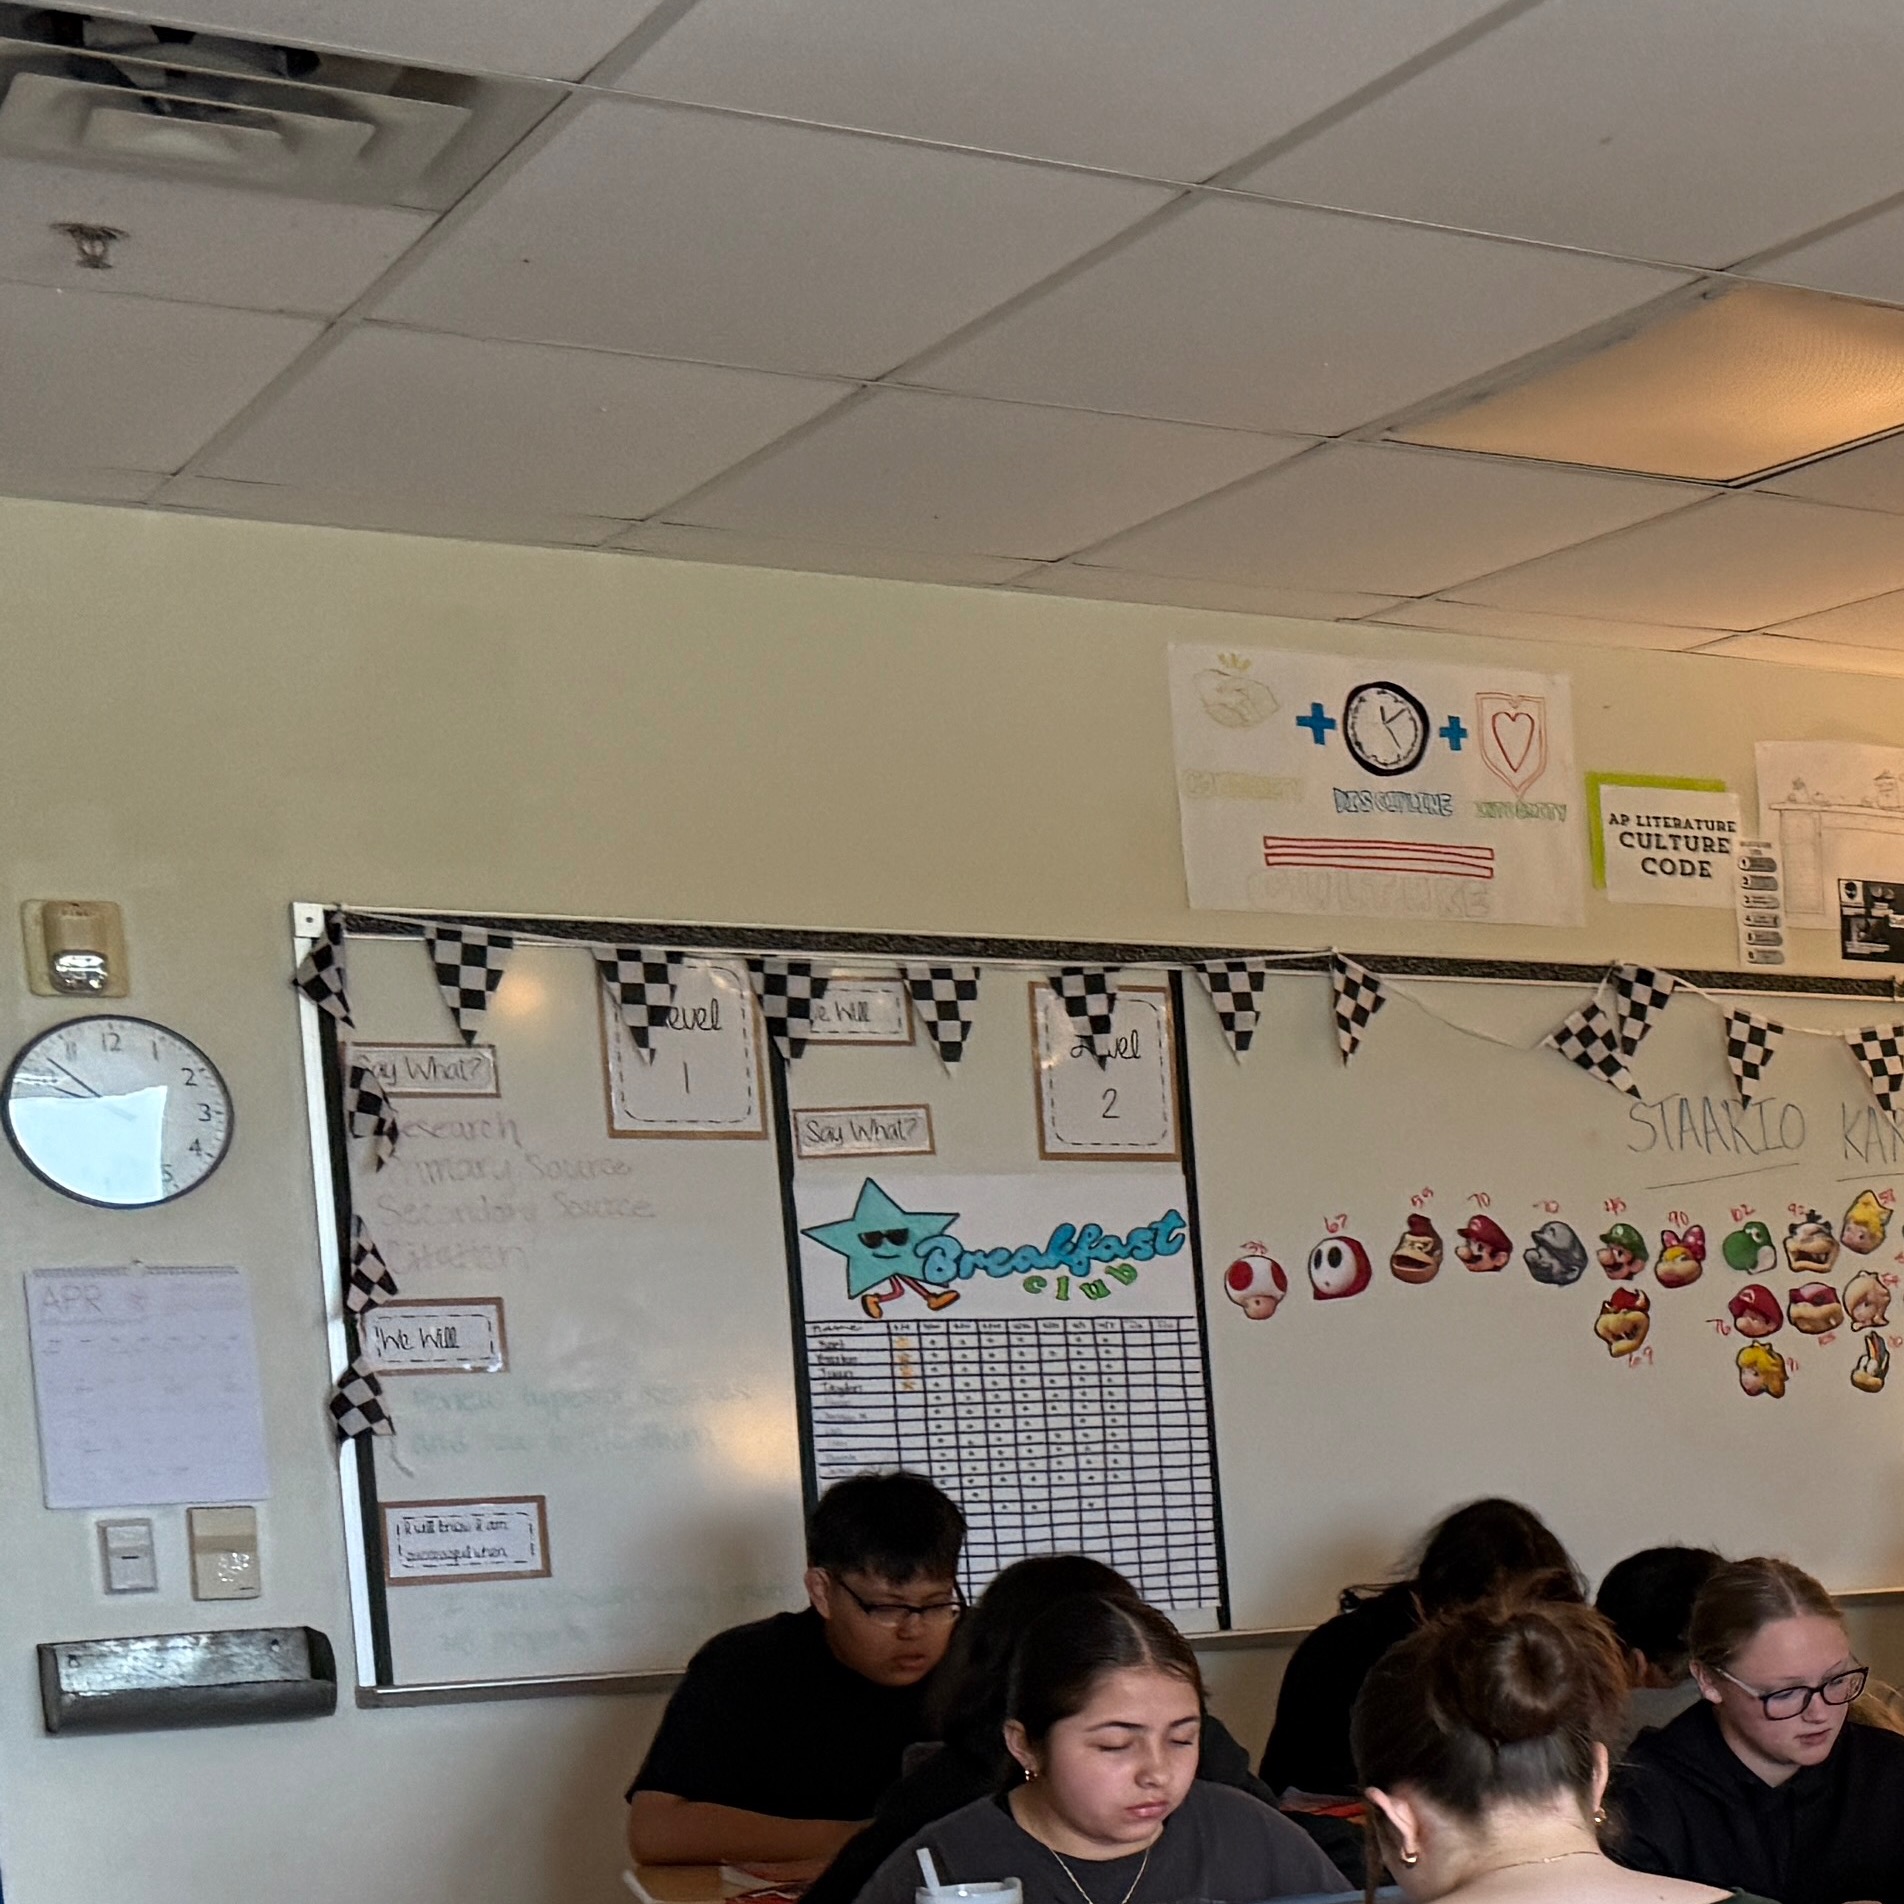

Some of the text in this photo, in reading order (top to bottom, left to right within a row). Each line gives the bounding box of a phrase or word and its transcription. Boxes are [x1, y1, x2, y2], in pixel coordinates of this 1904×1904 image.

[1608, 812, 1737, 833] AP LITERATURE
[1618, 831, 1732, 855] CULTURE
[1640, 856, 1714, 879] CODE
[665, 1000, 724, 1031] evel
[100, 1032, 123, 1053] 12
[181, 1067, 198, 1087] 2
[403, 1056, 483, 1083] What?
[199, 1104, 213, 1123] 3
[1101, 1088, 1122, 1120] 2
[400, 1114, 522, 1148] esearch
[805, 1114, 919, 1147] Say What?
[188, 1138, 203, 1154] 4
[914, 1208, 1187, 1286] Breakfast
[1022, 1262, 1140, 1301] club
